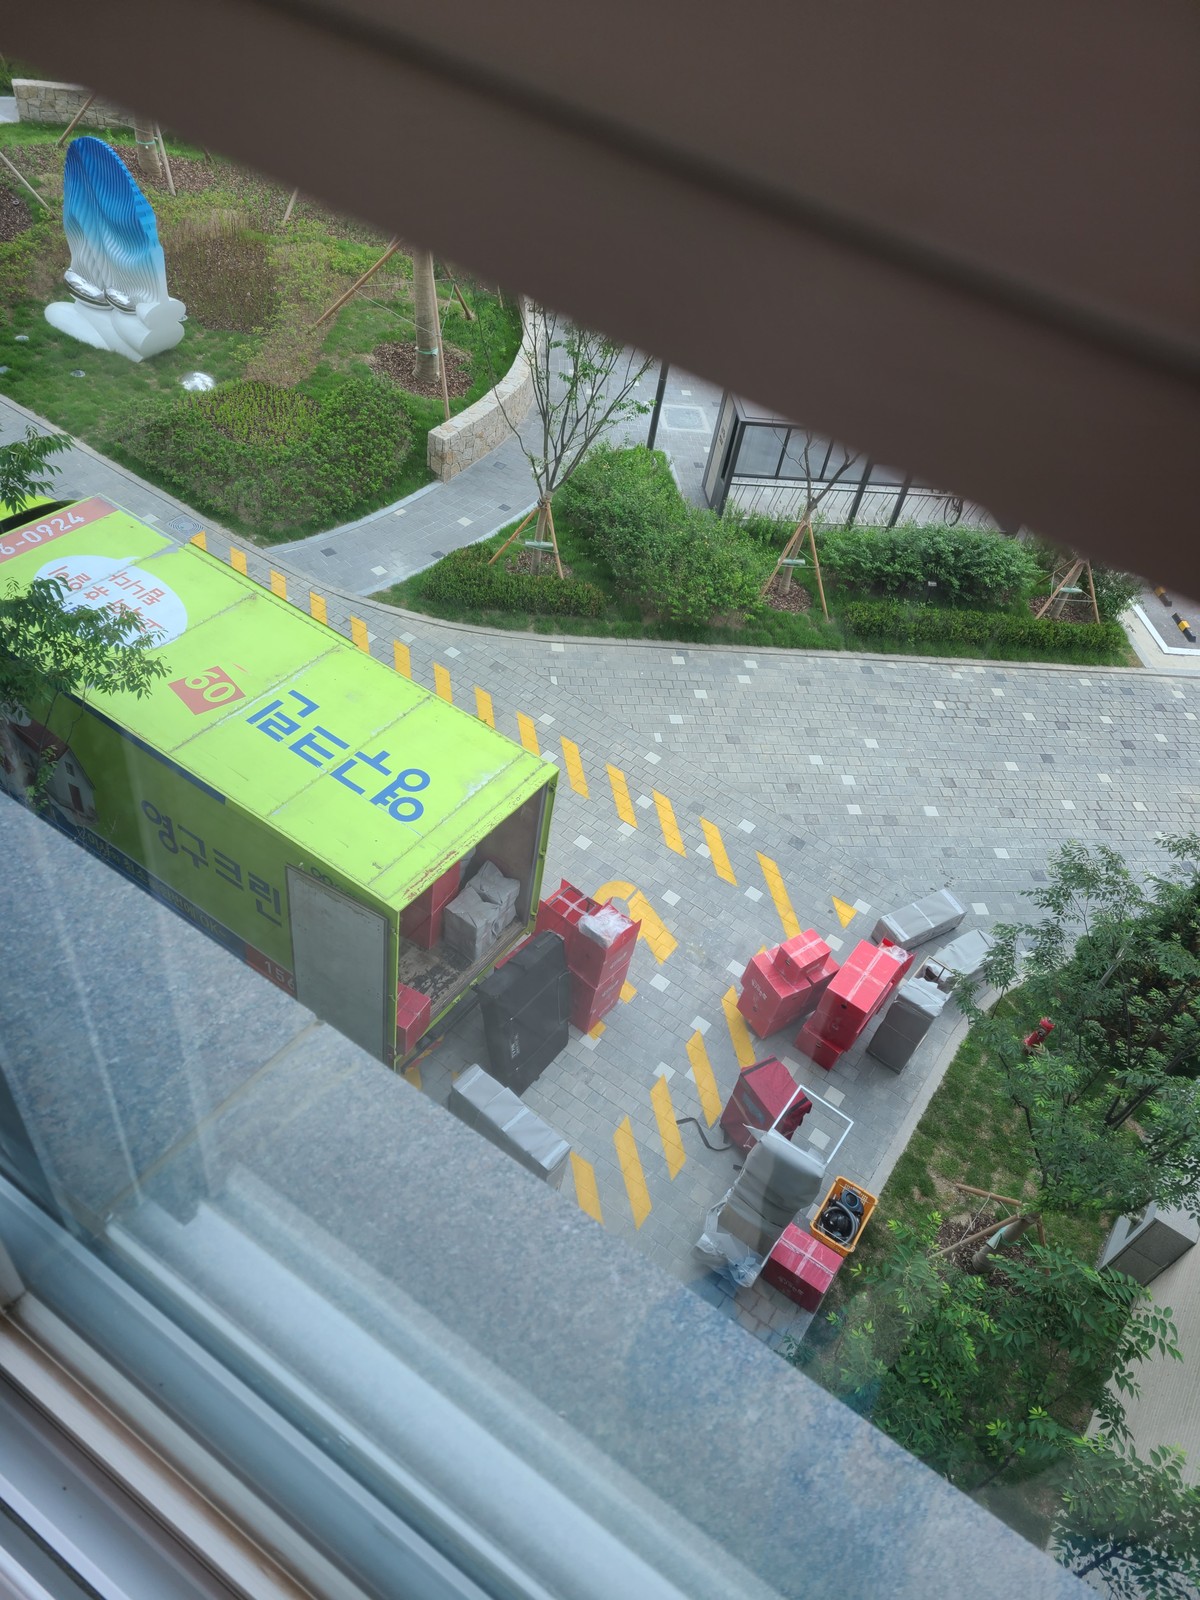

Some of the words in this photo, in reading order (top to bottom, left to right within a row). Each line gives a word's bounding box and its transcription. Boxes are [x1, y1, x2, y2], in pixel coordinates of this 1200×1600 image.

[108, 571, 167, 606] 됩니다
[246, 689, 431, 822] 영구크린
[141, 800, 282, 928] 영구크린
